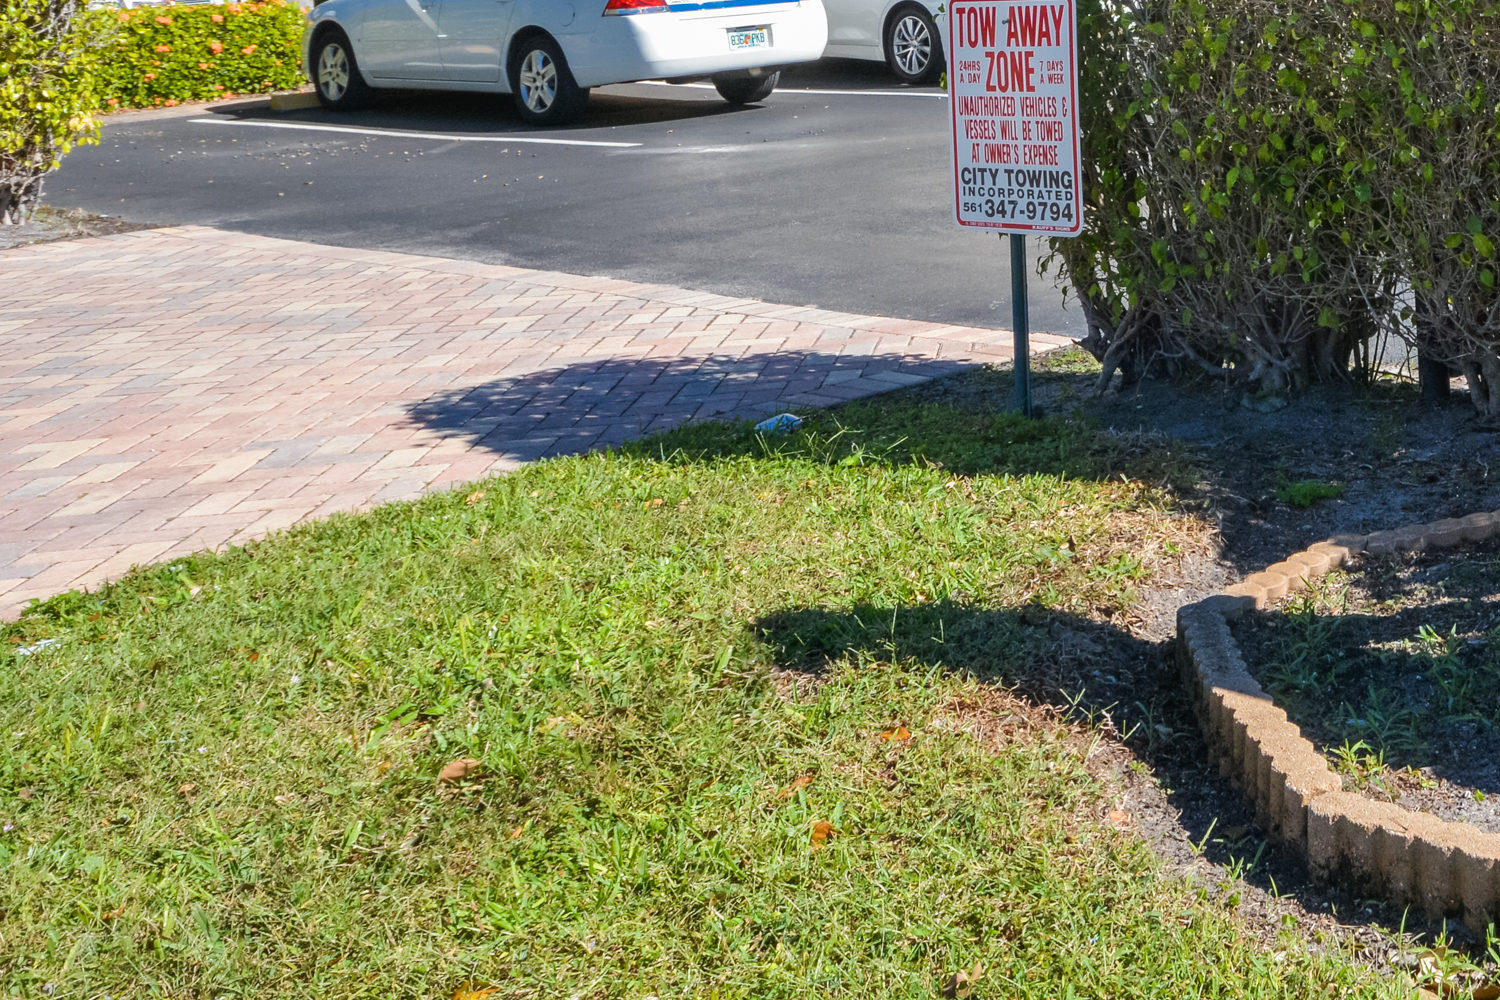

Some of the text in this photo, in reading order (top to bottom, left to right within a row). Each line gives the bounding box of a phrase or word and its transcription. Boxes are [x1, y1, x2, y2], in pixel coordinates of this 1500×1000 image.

[955, 4, 1065, 49] TOW AWAY
[959, 60, 981, 72] 24HRS
[984, 50, 1036, 93] ZONE
[1039, 60, 1064, 72] 7 DAYS
[959, 72, 981, 84] A DAY
[1039, 73, 1065, 85] A WEEK
[958, 95, 1068, 118] UNAUTHORIZED VEHICLES &
[964, 119, 1064, 142] VESSELS WILL BE TOWED
[971, 142, 1059, 166] AT OWNER'S EXPENSE
[961, 166, 1073, 190] CITY TOWING
[962, 185, 1074, 201] INCORPORATED
[963, 198, 1074, 223] 561 347-9794
